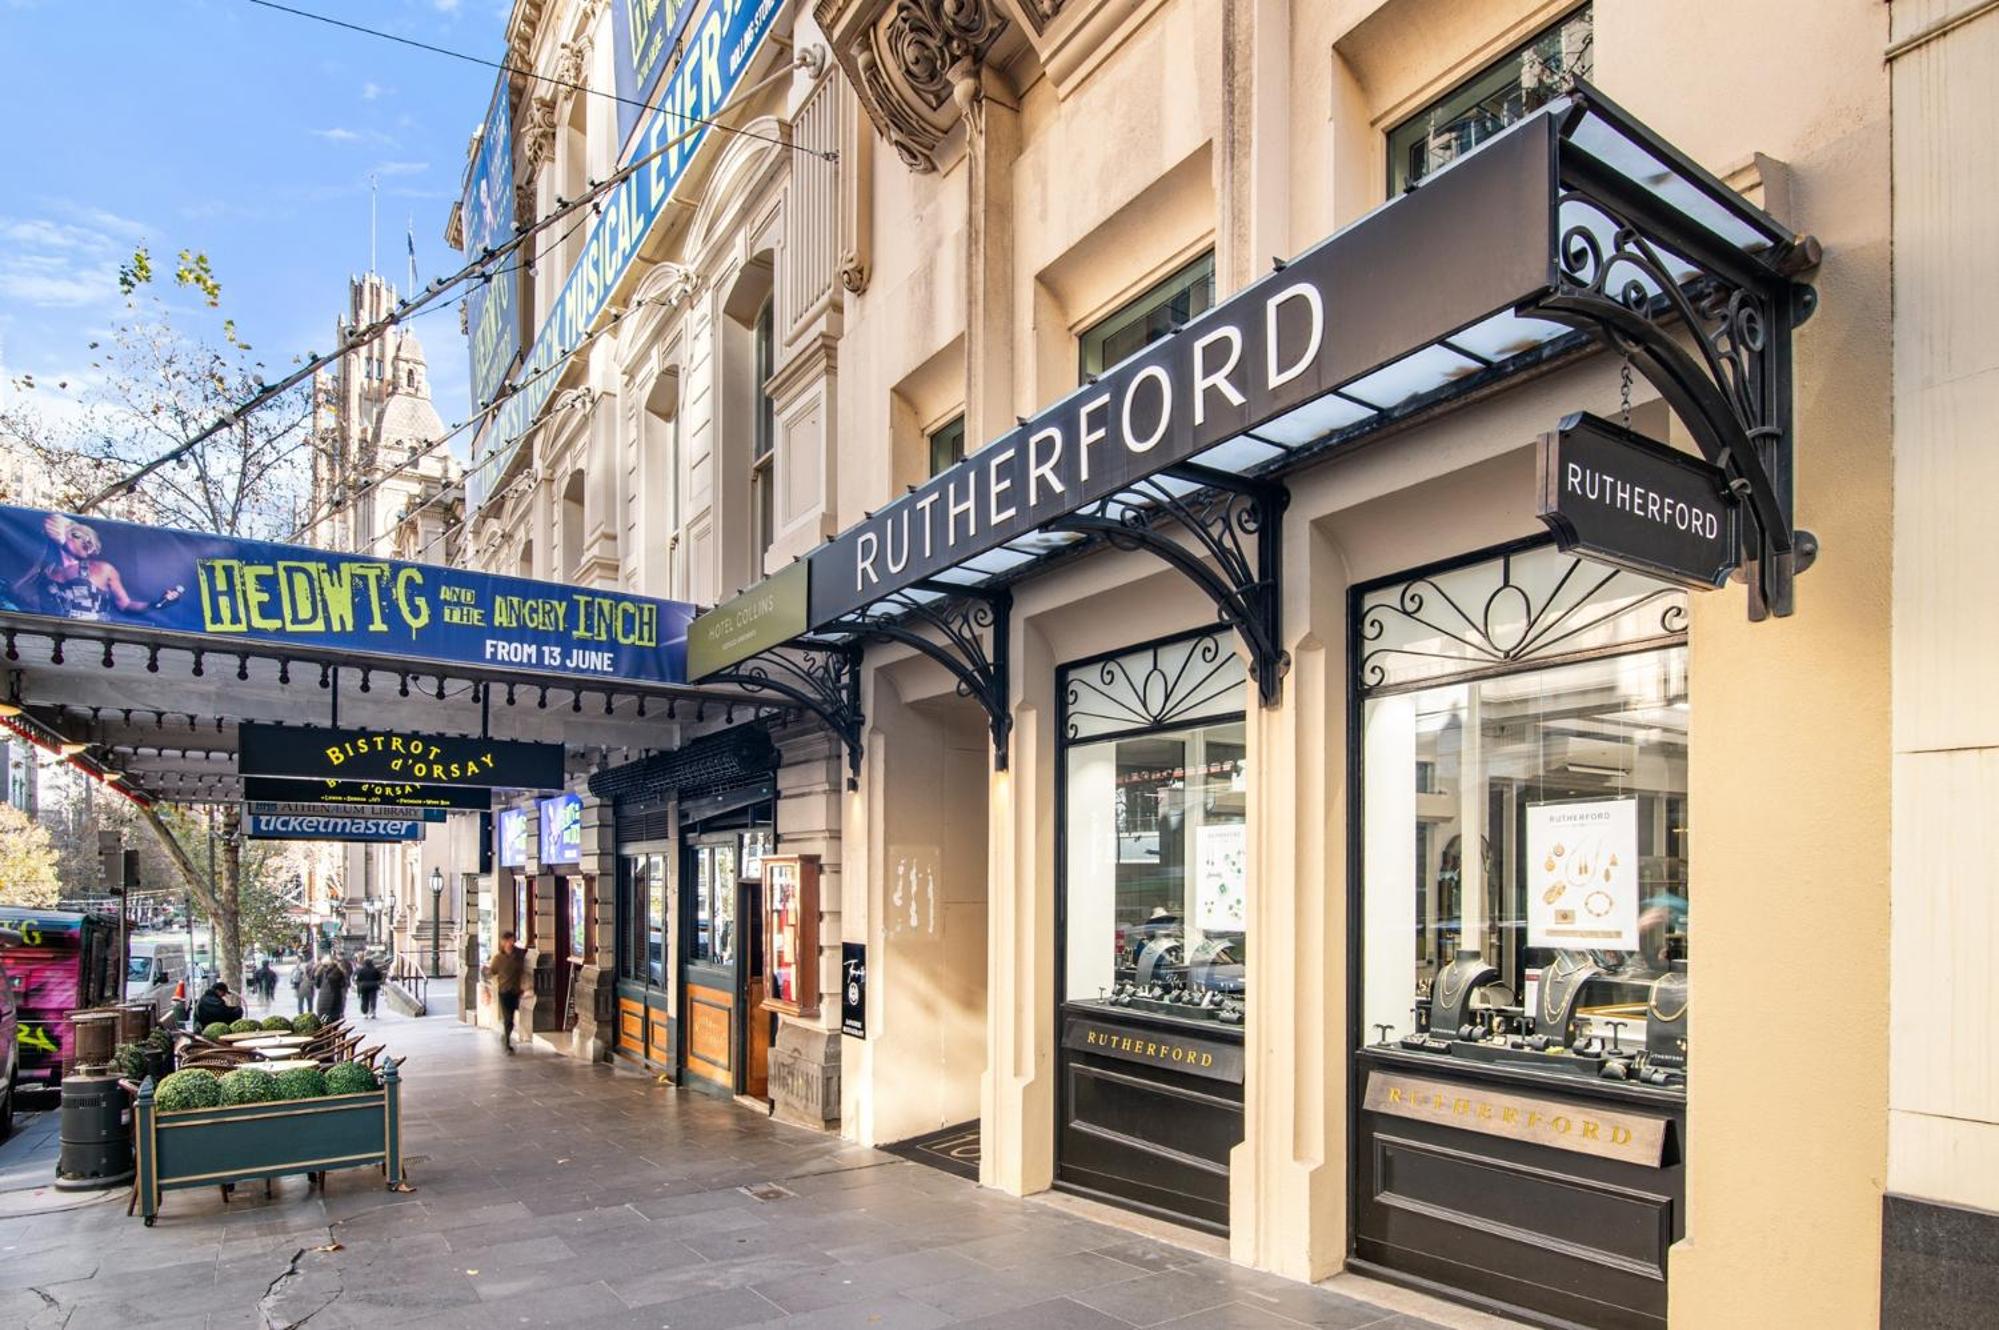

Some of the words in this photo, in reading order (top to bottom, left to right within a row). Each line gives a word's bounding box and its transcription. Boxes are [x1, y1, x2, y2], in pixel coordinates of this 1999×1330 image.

[565, 163, 645, 351] MUSICAL
[855, 282, 1325, 592] RUTHERFORD
[1566, 461, 1719, 541] RUTHERFORD
[196, 557, 431, 641] HEDWIG
[440, 585, 476, 605] AND
[444, 605, 487, 627] THE
[493, 594, 568, 632] ANGRY
[572, 593, 657, 648] INCH
[485, 639, 537, 665] FROM
[541, 645, 561, 667] 13
[565, 648, 614, 673] JUNE
[325, 736, 441, 766] BISTROT
[258, 815, 413, 836] ticketmaster
[1549, 811, 1611, 823] RUTHERFORD
[1087, 1030, 1213, 1067] RUTHERFORD
[1387, 1087, 1633, 1146] RUTHERFORD
